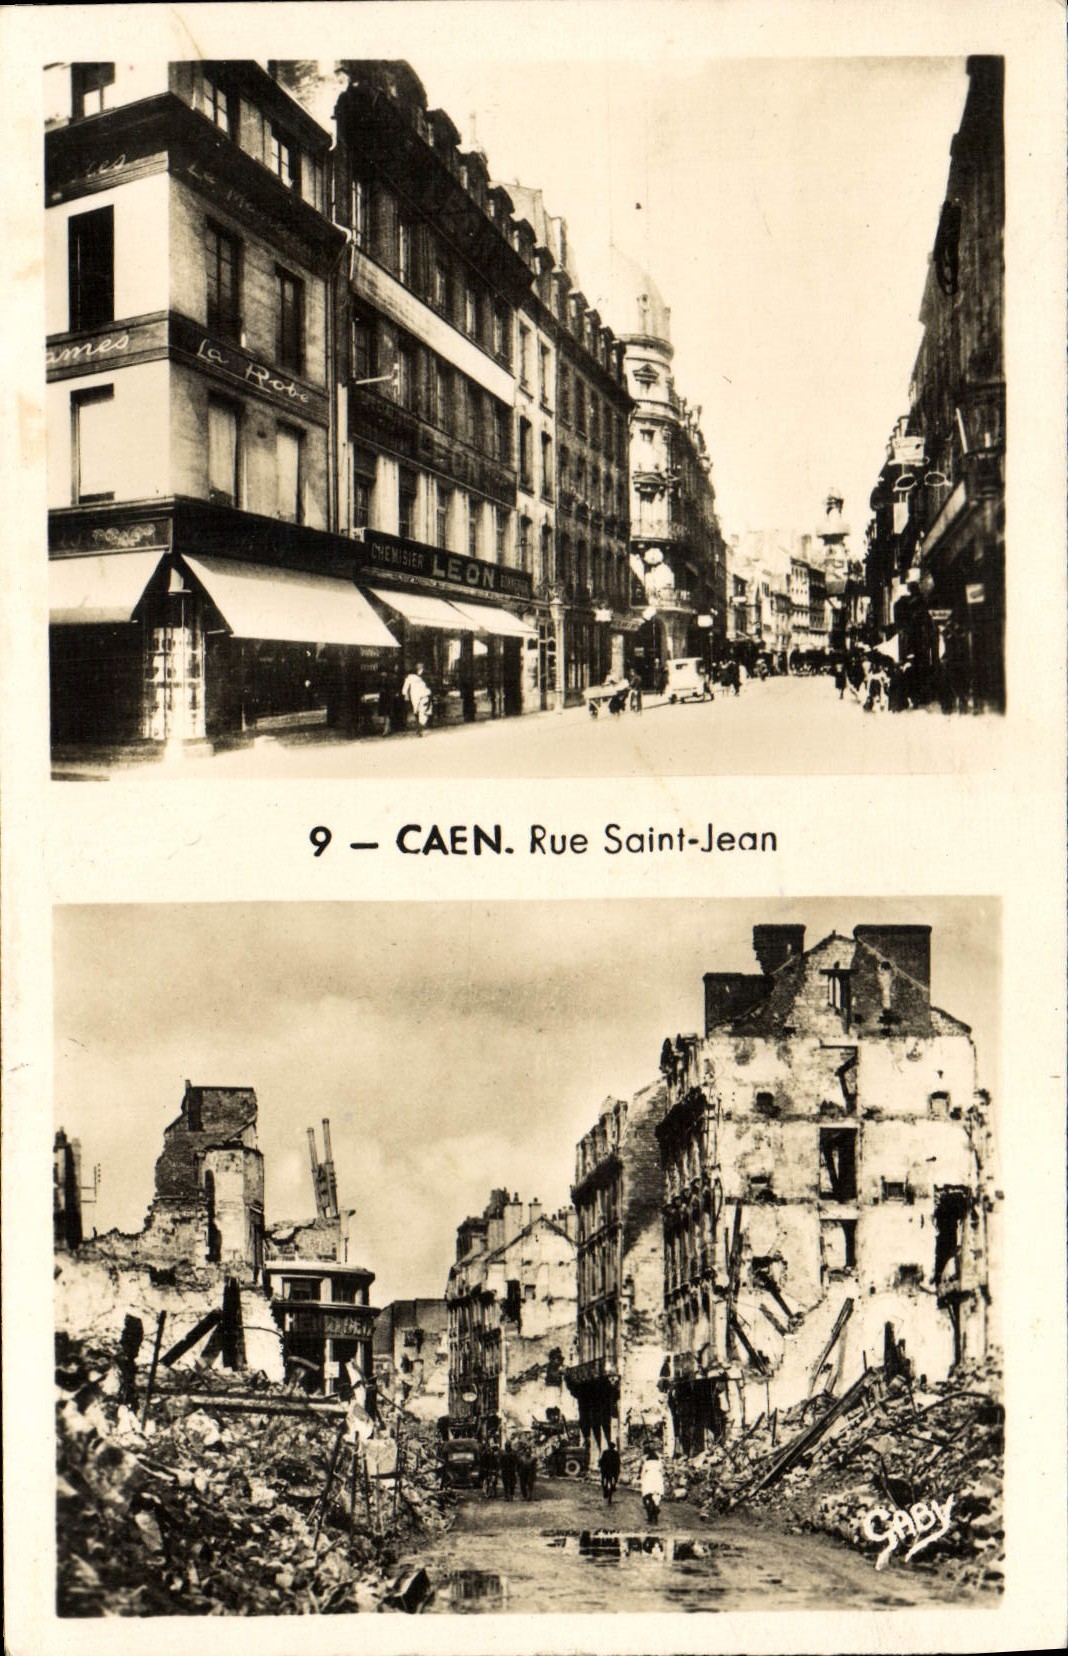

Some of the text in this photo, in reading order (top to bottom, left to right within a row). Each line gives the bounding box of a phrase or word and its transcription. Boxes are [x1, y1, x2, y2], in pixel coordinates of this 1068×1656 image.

[199, 338, 310, 403] La Robe
[371, 543, 424, 569] CHEMISIER
[432, 554, 495, 589] LEON
